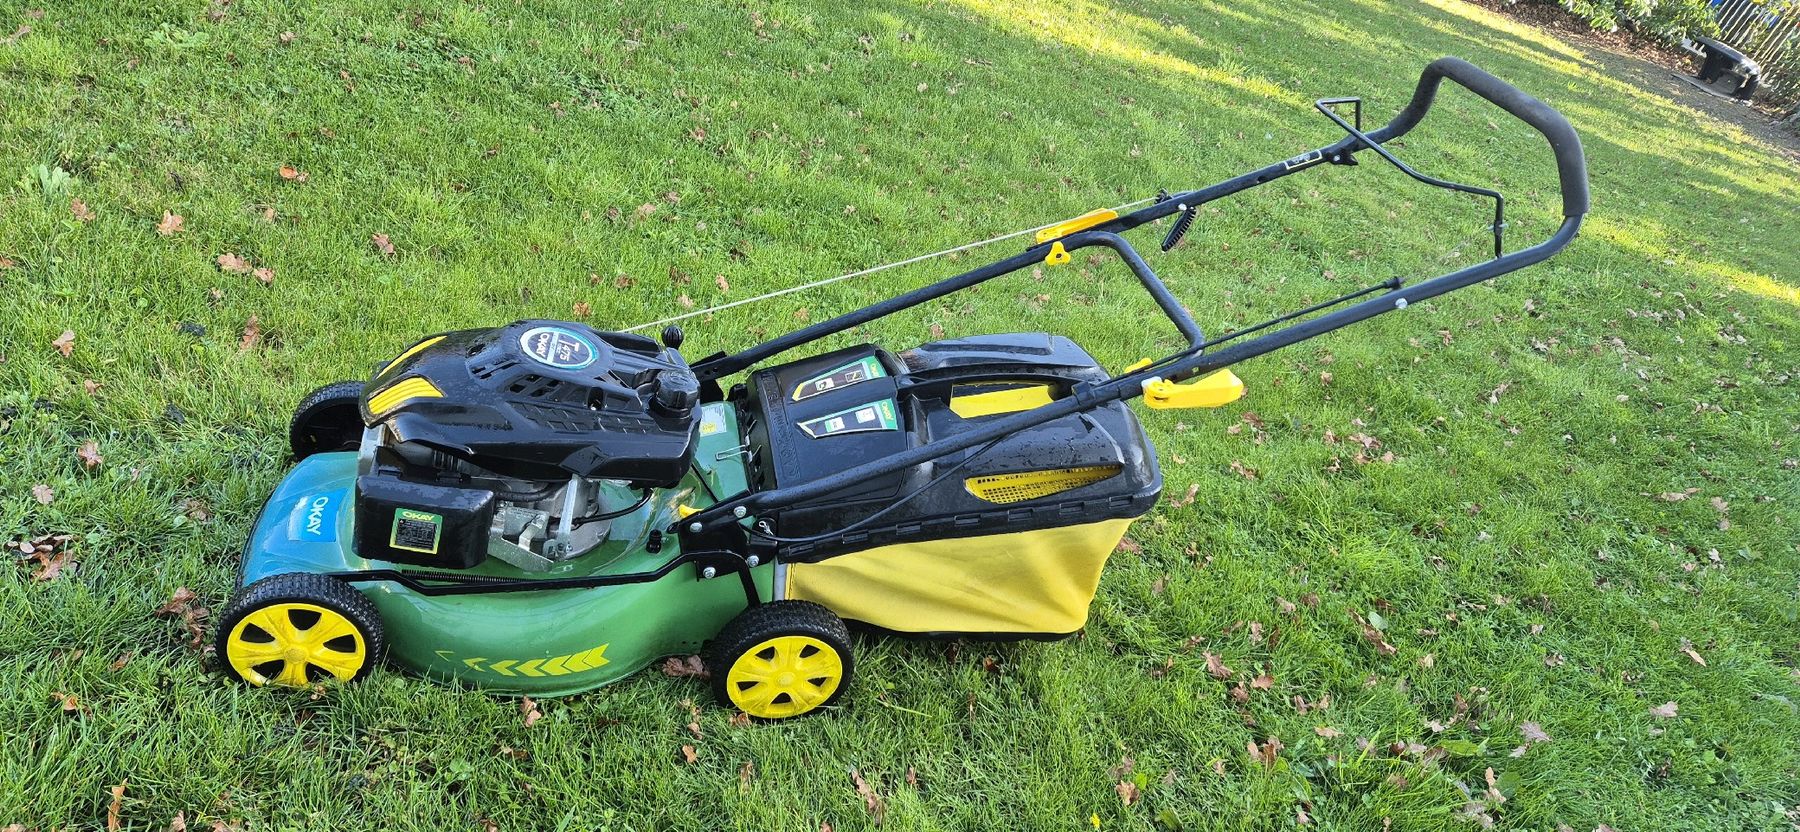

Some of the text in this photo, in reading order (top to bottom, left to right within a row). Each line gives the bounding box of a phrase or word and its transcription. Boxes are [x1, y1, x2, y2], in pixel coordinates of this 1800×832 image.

[536, 333, 550, 358] OKAY
[306, 496, 329, 536] OKAY
[402, 511, 435, 521] OKAY
